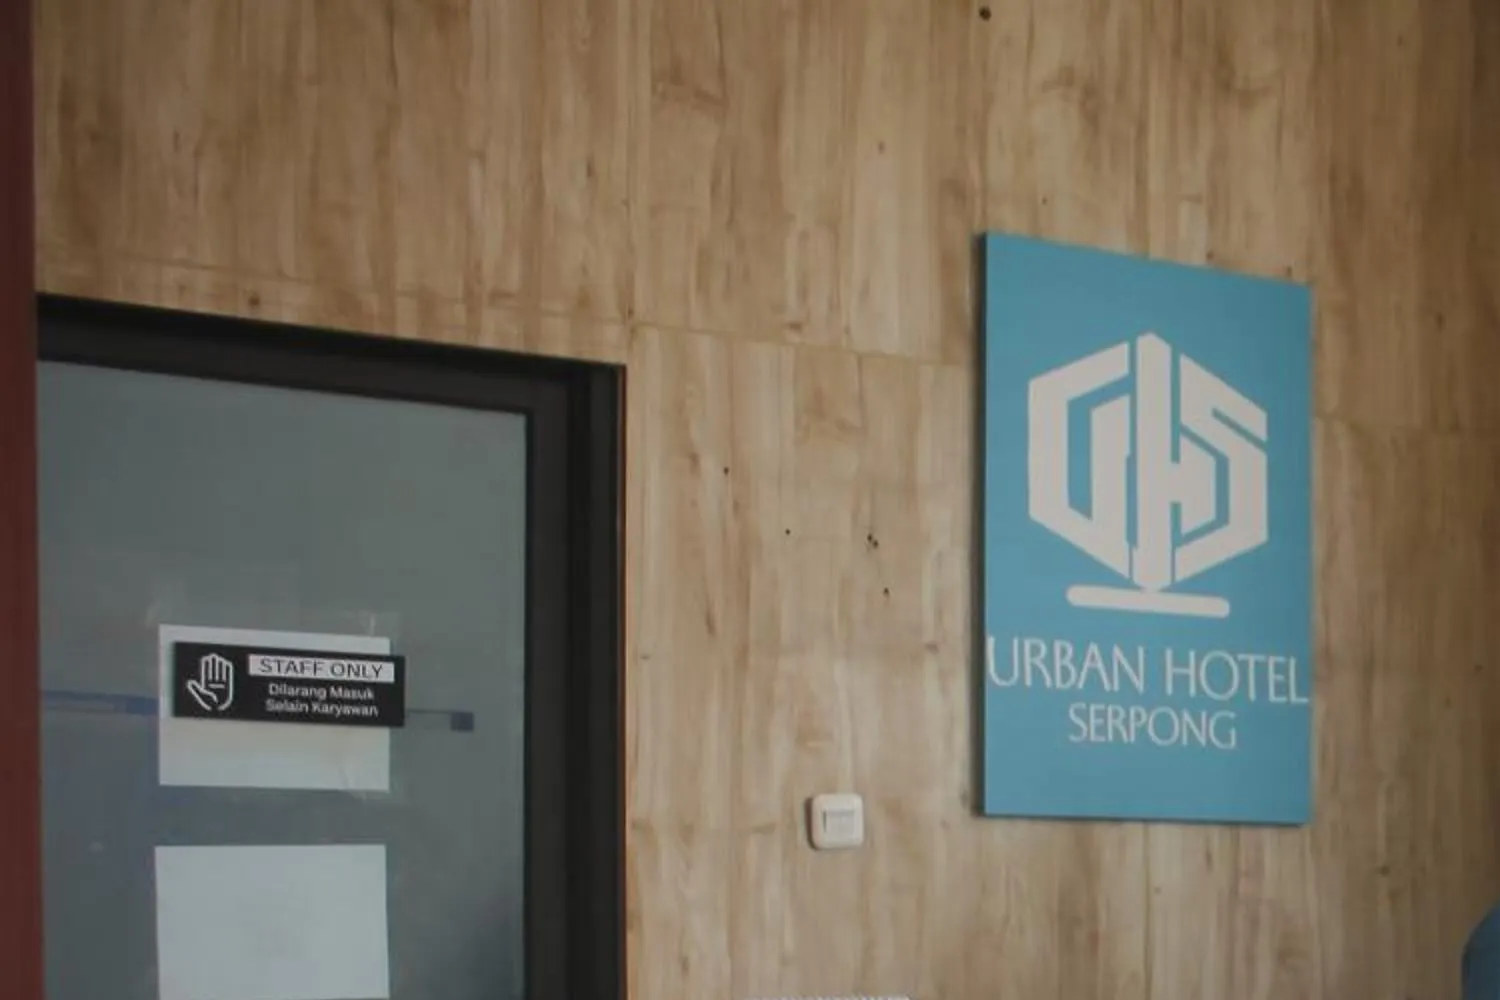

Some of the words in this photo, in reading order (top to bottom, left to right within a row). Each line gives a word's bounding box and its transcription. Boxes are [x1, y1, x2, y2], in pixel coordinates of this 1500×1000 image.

[259, 657, 325, 676] STAFF
[330, 661, 383, 679] ONLY
[987, 635, 1145, 694] URBAN
[1165, 648, 1309, 704] HOTEL
[268, 682, 327, 700] Dilarang
[329, 685, 375, 700] Masuk
[265, 697, 309, 713] Selain
[311, 700, 380, 718] Karyawan
[1068, 702, 1237, 749] SERPONG
